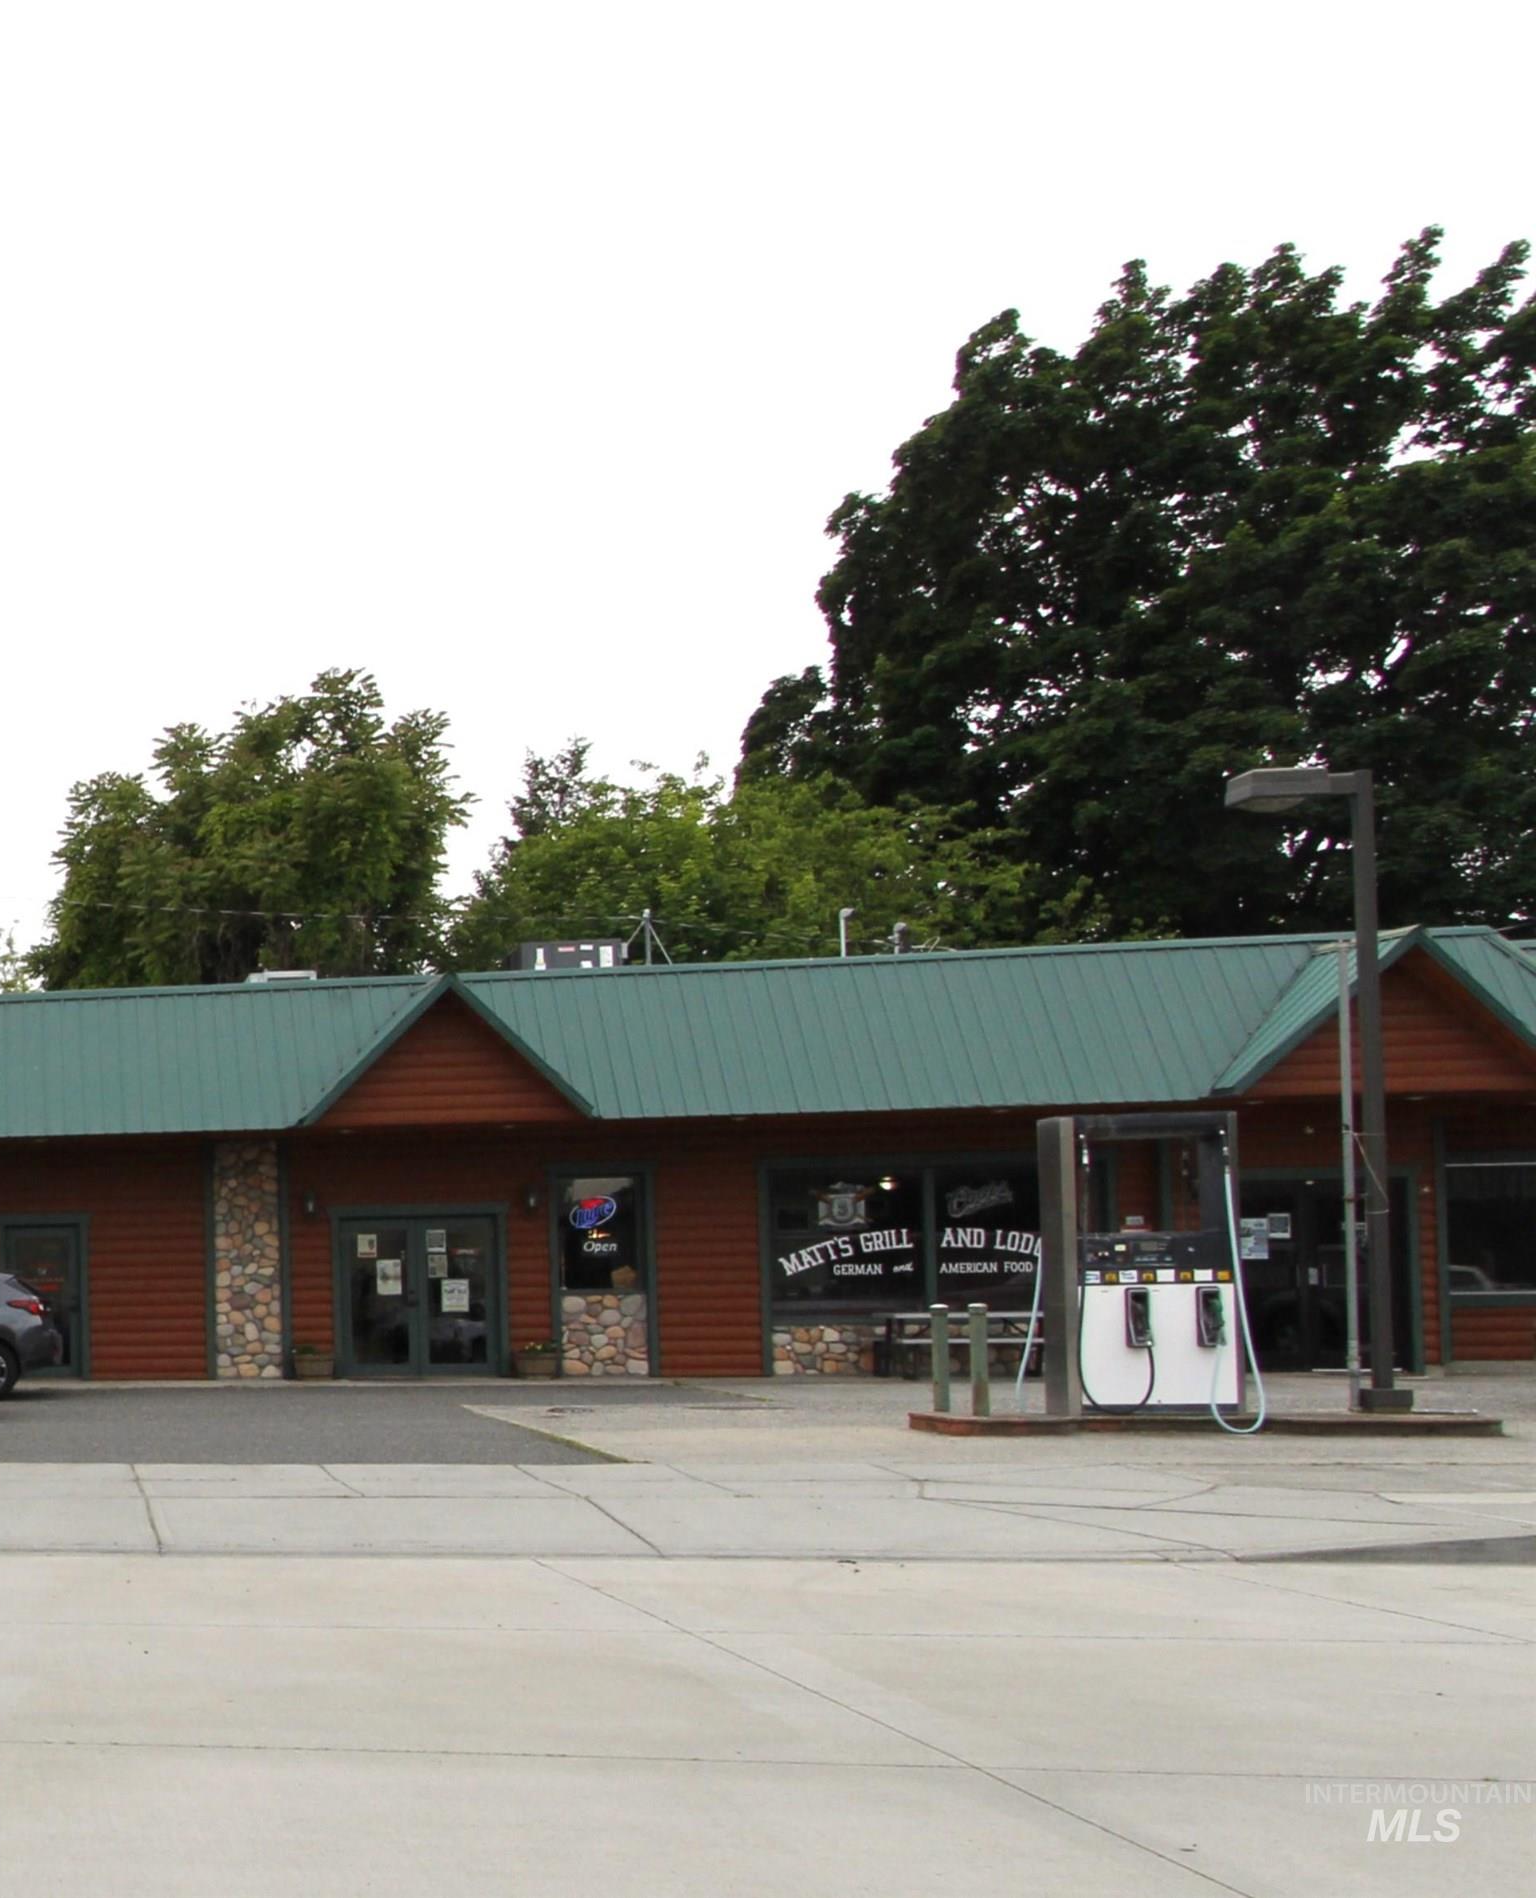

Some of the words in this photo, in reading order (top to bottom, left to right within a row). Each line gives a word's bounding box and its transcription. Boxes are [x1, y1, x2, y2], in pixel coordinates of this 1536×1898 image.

[583, 1240, 618, 1254] Open
[778, 1236, 854, 1276] MATT'S
[859, 1228, 914, 1253] GRILL
[940, 1227, 985, 1249] AND
[832, 1263, 883, 1276] GERMAN
[892, 1261, 914, 1273] and
[939, 1261, 998, 1275] AMERICAN
[1003, 1261, 1033, 1273] FOOD
